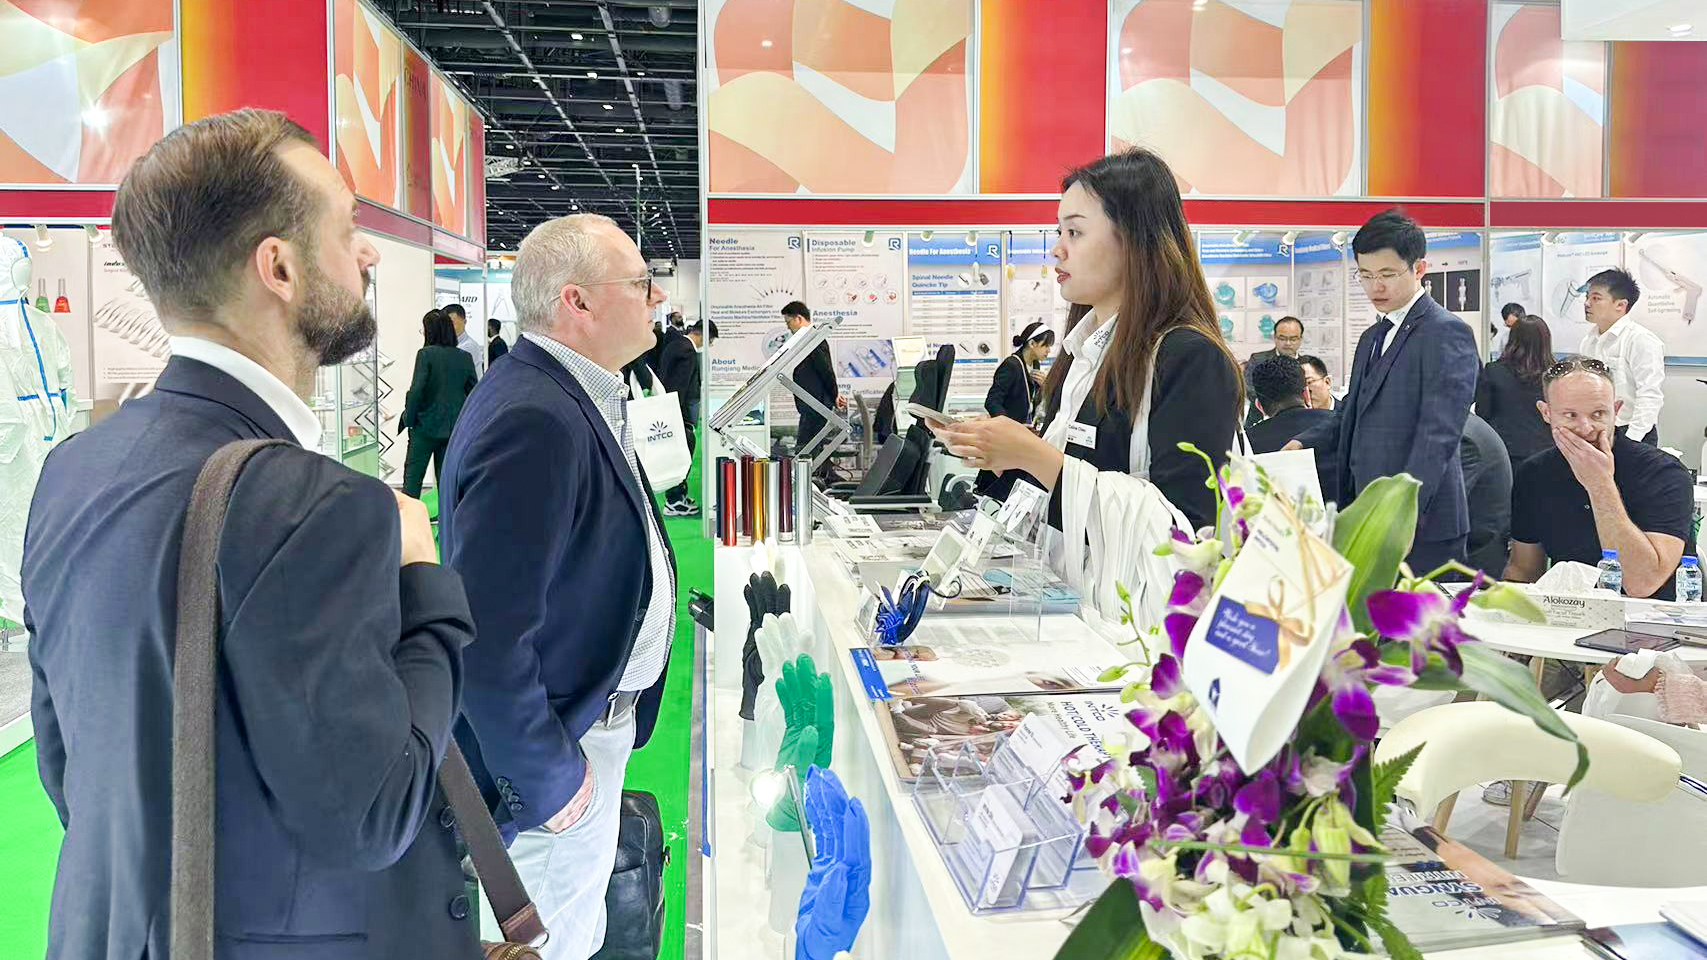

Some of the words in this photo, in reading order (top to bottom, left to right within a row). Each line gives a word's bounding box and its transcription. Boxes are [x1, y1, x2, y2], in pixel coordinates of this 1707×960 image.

[812, 239, 856, 247] Disposable
[647, 431, 674, 442] INTCO
[1543, 595, 1586, 609] Alokozay
[1386, 881, 1484, 897] SYNGUA
